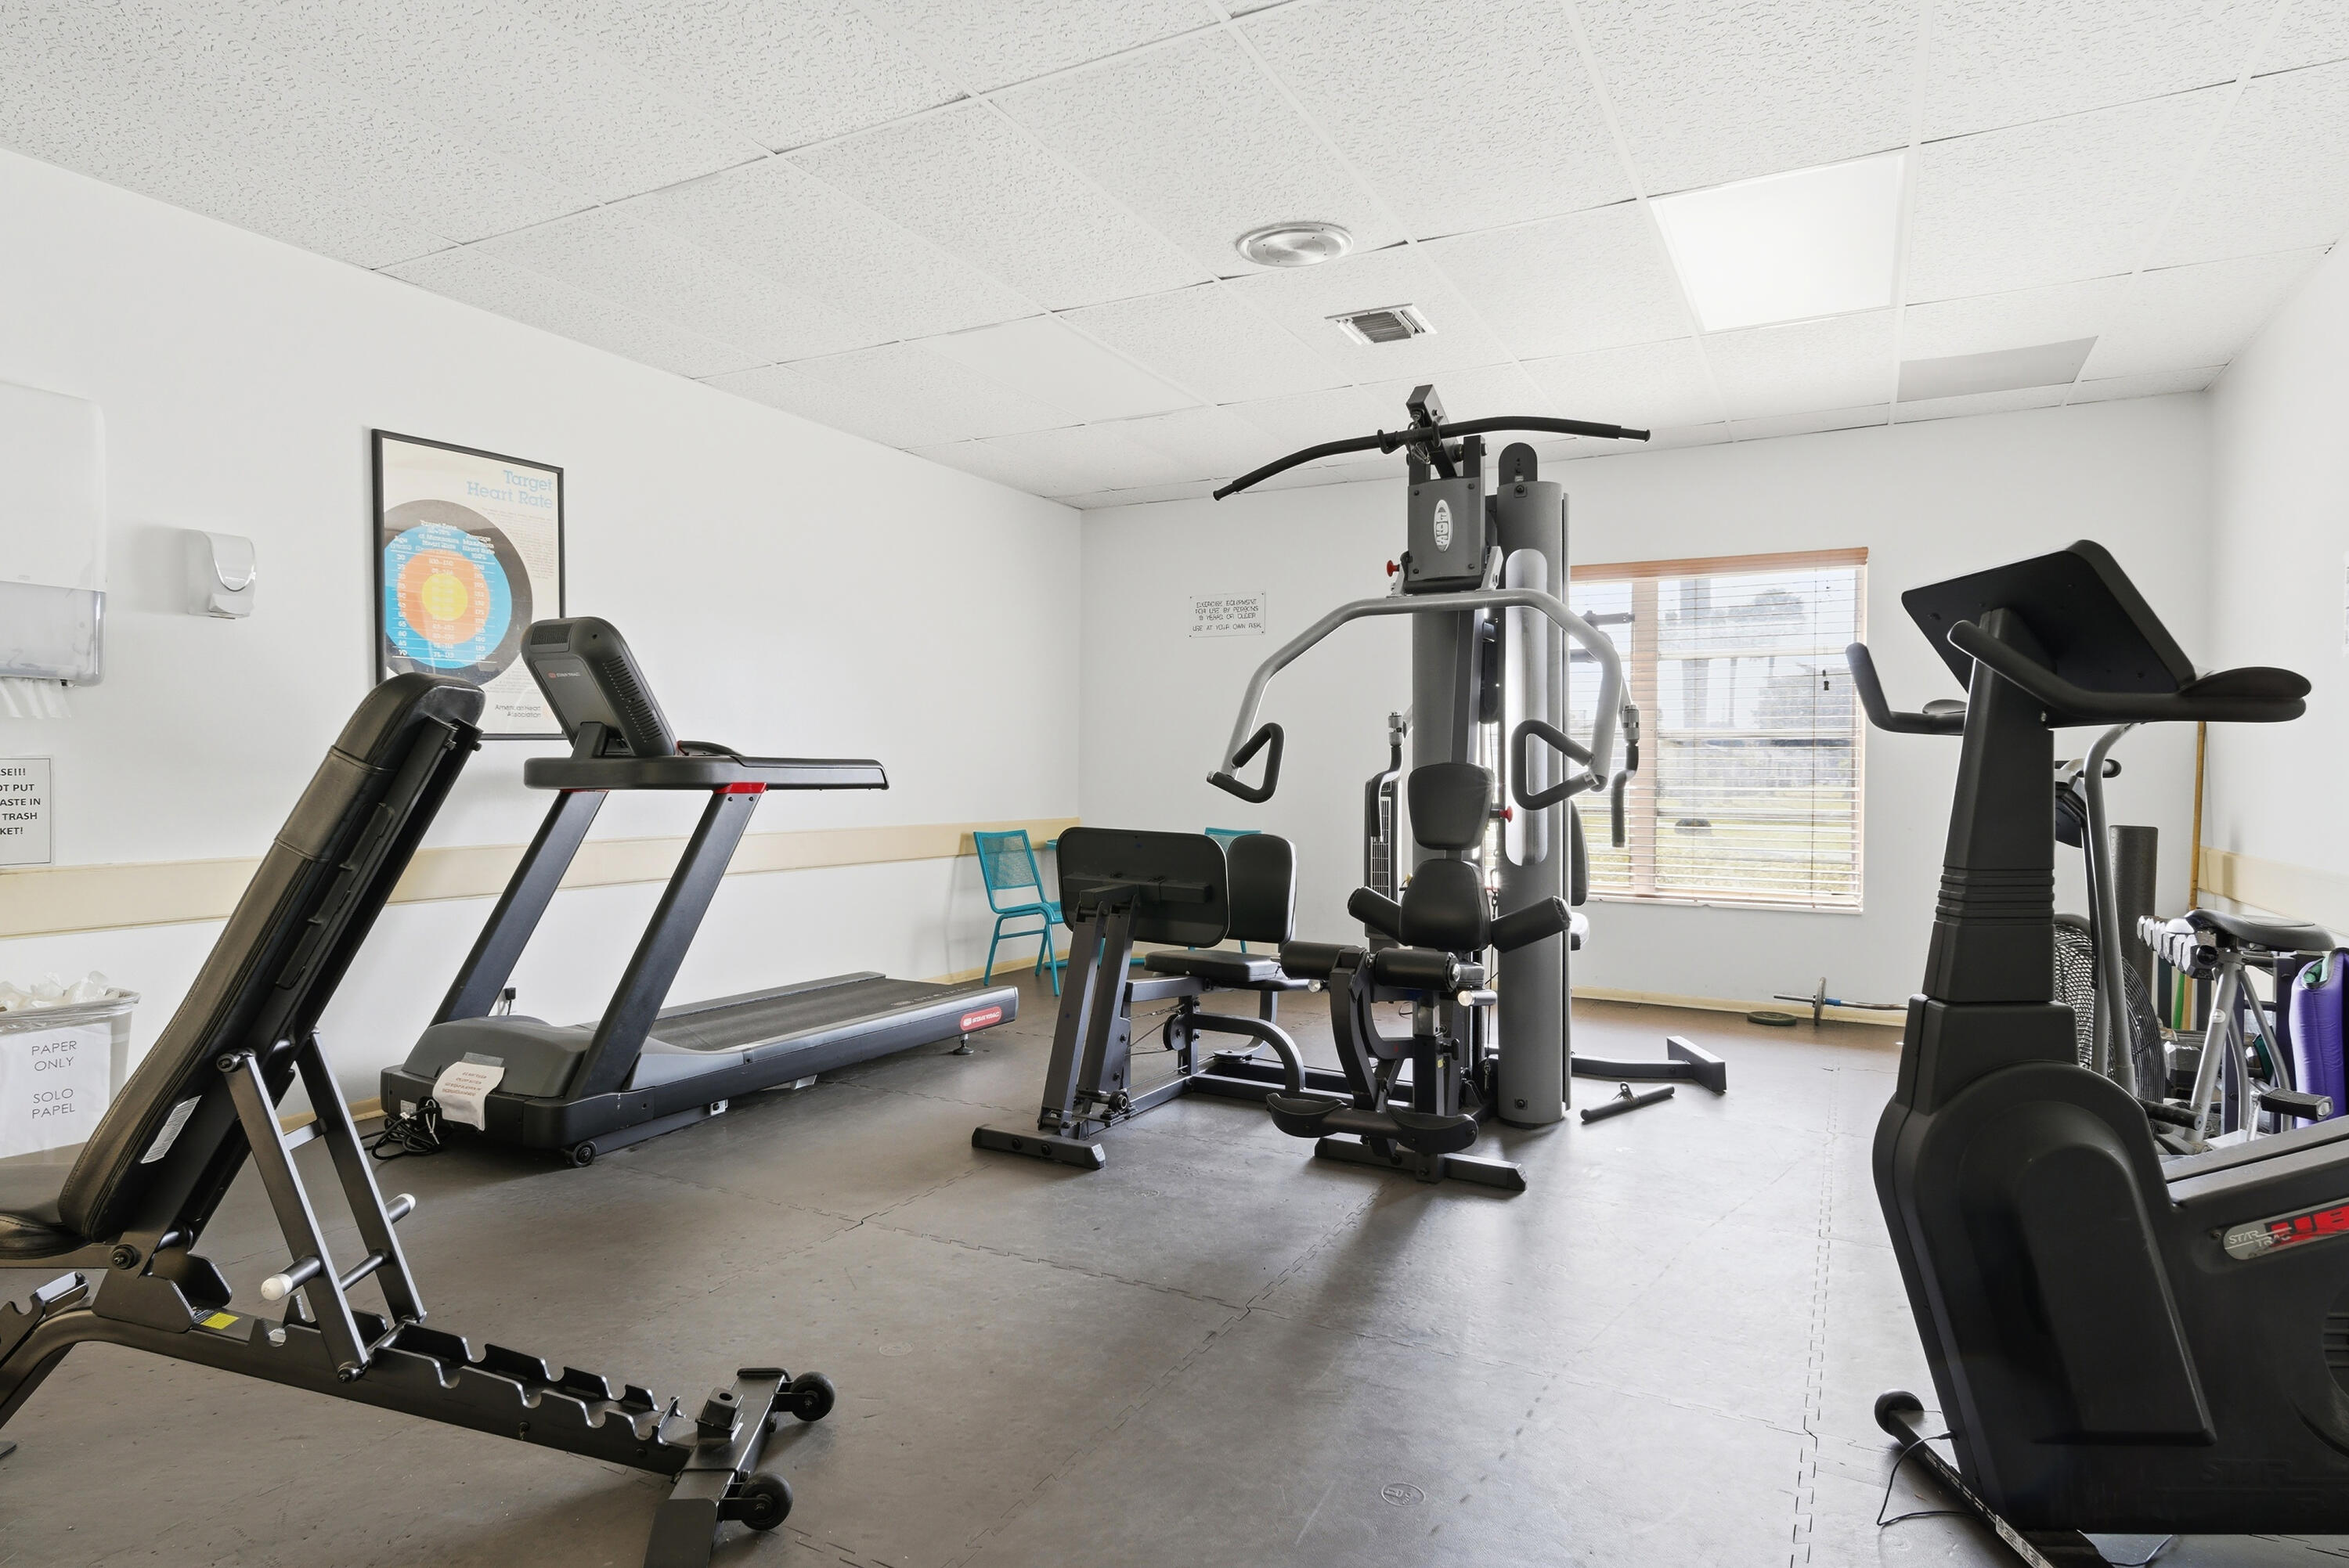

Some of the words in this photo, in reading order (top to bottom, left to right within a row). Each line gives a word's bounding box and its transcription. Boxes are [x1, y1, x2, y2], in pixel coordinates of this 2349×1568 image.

[503, 470, 553, 492] Target
[466, 481, 514, 502] Heart
[518, 490, 553, 509] Rate
[13, 784, 35, 792] PUT
[30, 798, 41, 806] IN
[2, 812, 38, 820] TRASH
[31, 1040, 77, 1055] PAPER
[34, 1056, 74, 1071] ONLY
[33, 1088, 74, 1104] SOLO
[32, 1103, 75, 1119] PAPEL
[2229, 1230, 2259, 1245] STAR
